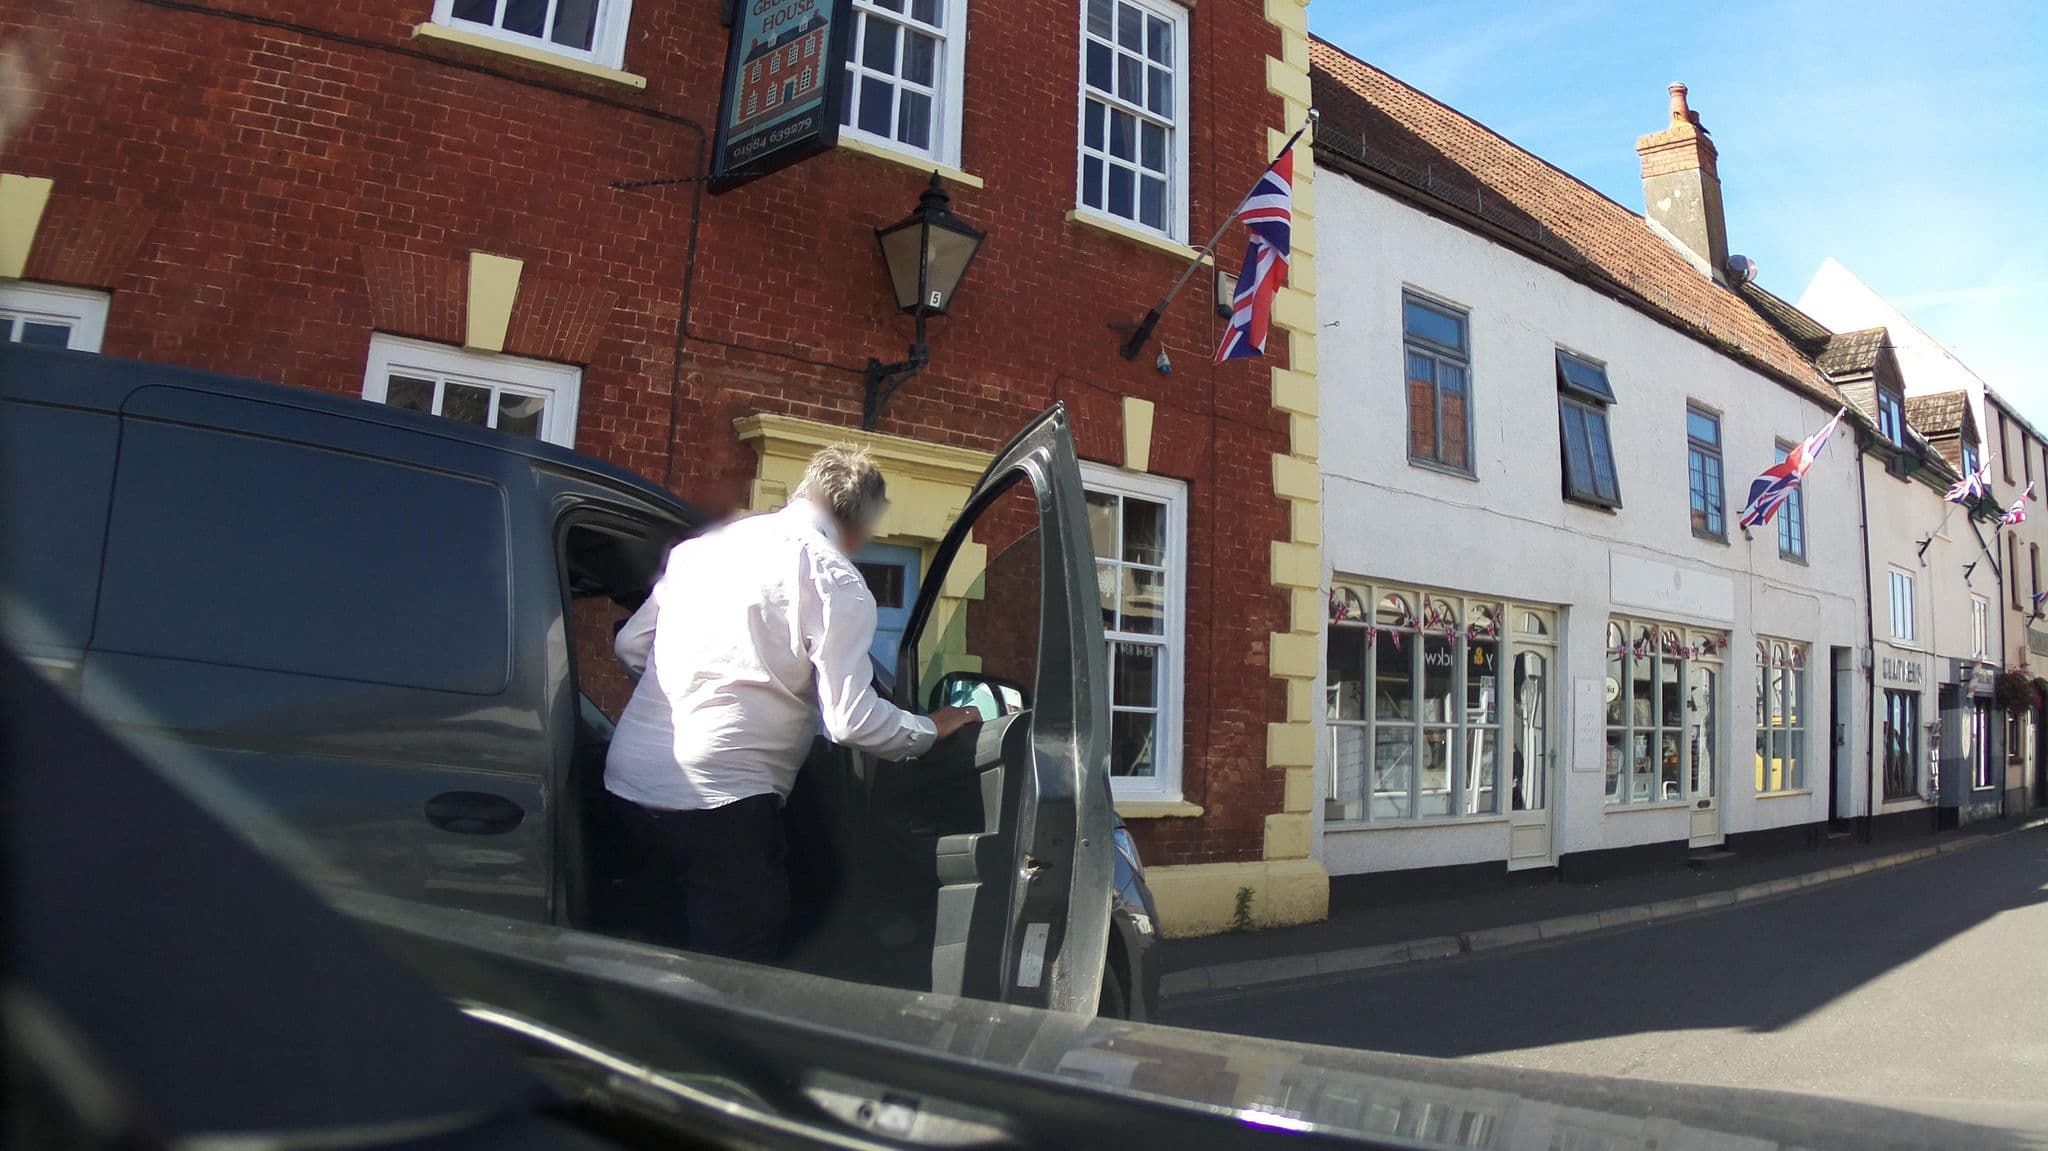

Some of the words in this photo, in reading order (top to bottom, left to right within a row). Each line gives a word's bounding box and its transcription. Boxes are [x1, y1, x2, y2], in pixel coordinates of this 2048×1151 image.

[752, 0, 784, 16] GEO
[761, 0, 815, 34] HOUSE
[733, 136, 767, 157] 01984
[769, 117, 813, 143] 639279
[932, 293, 939, 304] 5
